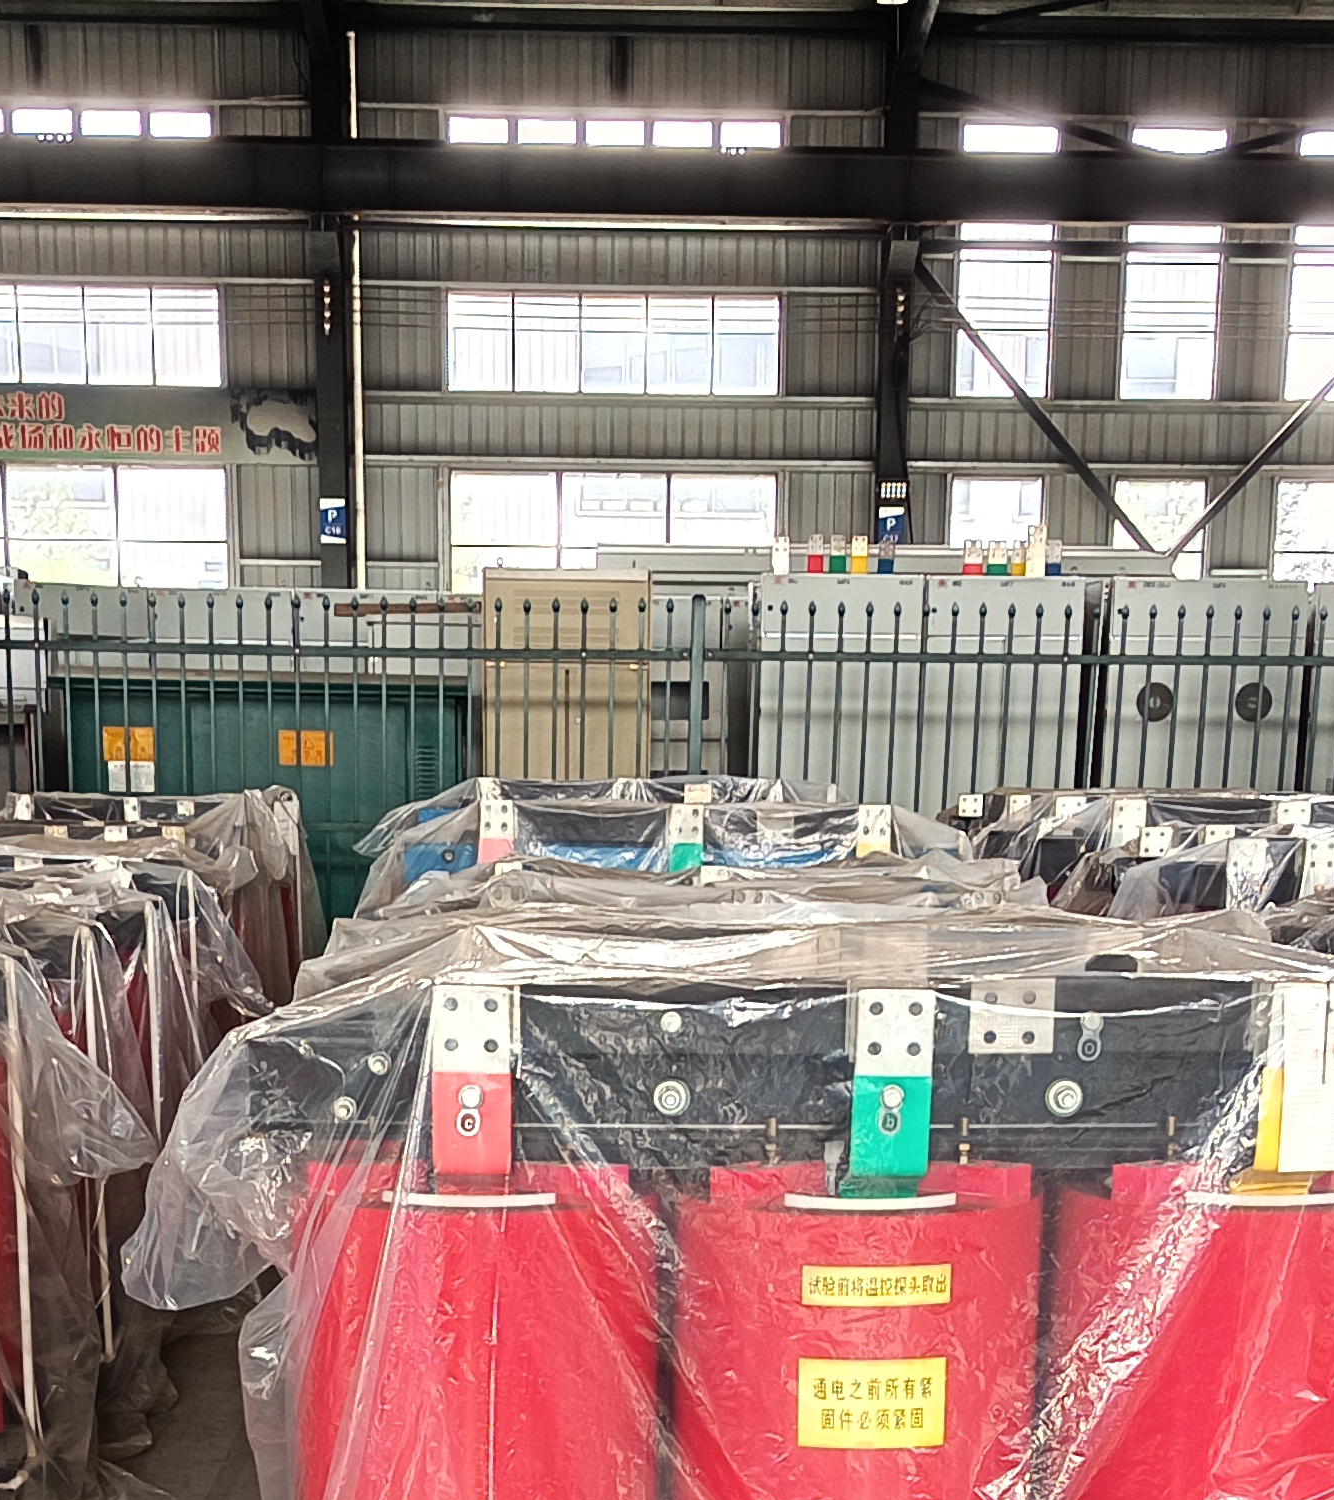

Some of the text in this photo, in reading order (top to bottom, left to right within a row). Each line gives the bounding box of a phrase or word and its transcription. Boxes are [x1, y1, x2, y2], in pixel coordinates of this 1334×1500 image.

[327, 509, 338, 523] P
[886, 517, 897, 532] P
[808, 1273, 948, 1297] 试验前将温控探头取出
[813, 1376, 934, 1401] 通电之前所有紧
[821, 1407, 925, 1431] 固件必须紧固
